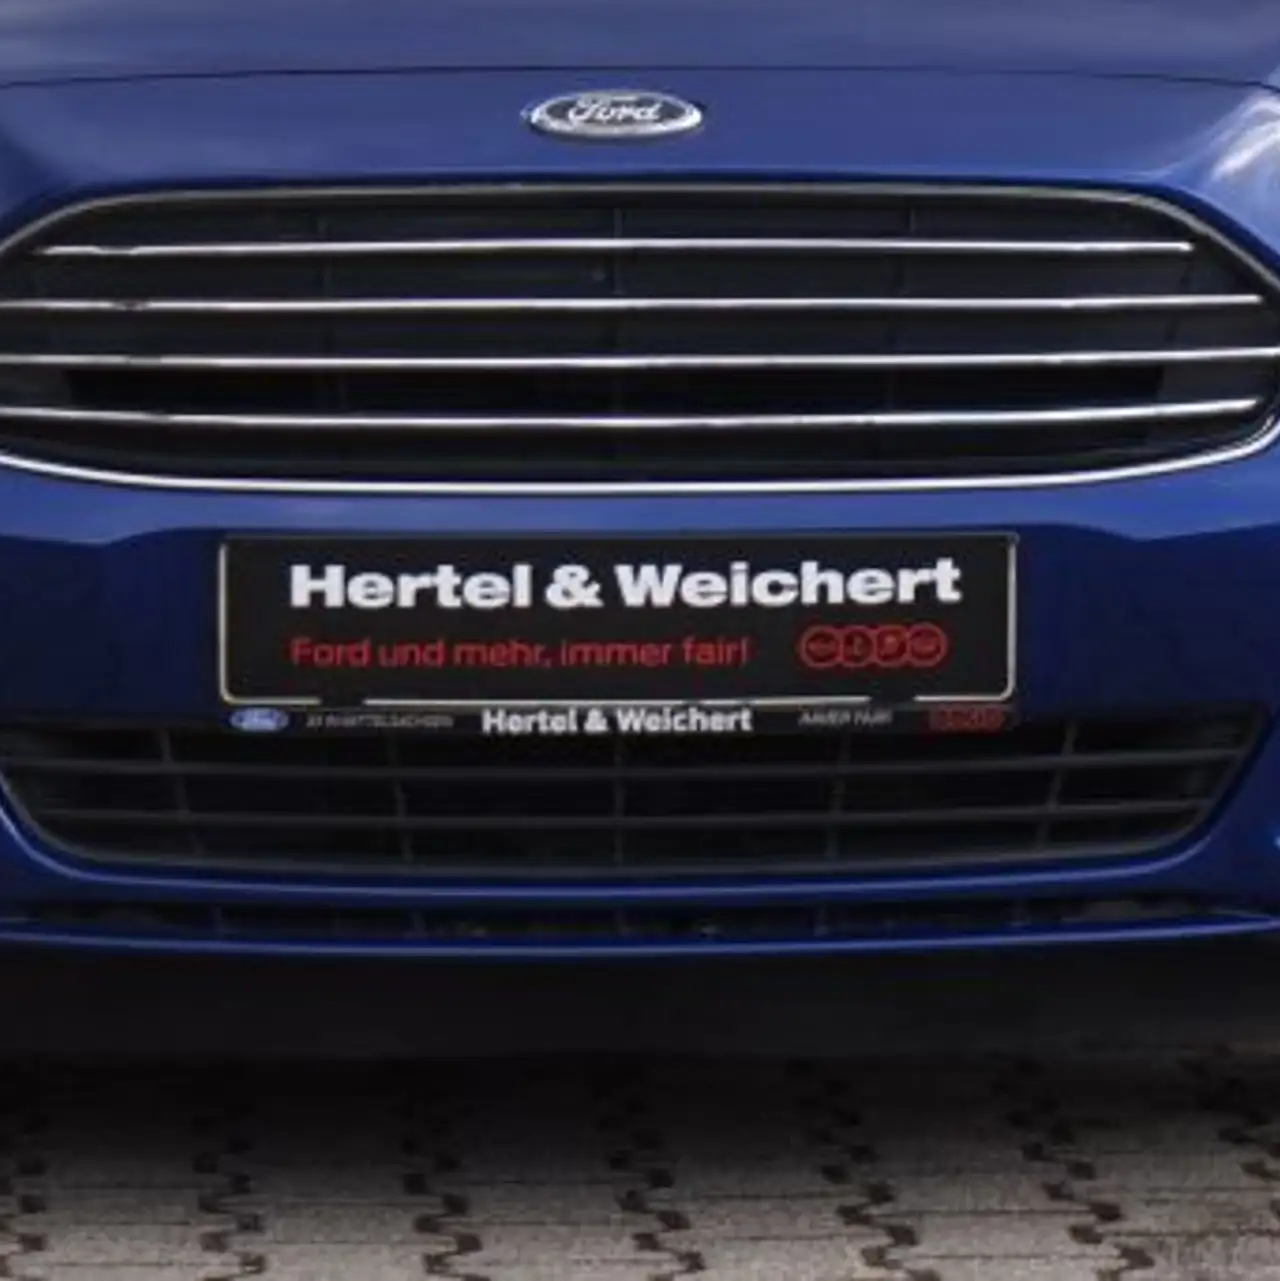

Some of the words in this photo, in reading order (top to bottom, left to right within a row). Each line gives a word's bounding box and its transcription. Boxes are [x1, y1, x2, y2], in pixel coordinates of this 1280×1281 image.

[568, 98, 664, 124] Ford
[289, 564, 534, 610] Hertel
[544, 564, 605, 610] &
[613, 557, 963, 608] Weichert
[289, 637, 370, 668] Ford
[379, 638, 445, 667] und
[454, 637, 553, 668] mehr,
[561, 636, 673, 667] immer
[682, 634, 750, 666] fair!
[481, 707, 578, 734] Hertel
[584, 708, 609, 734] &
[617, 705, 754, 734] Weichert
